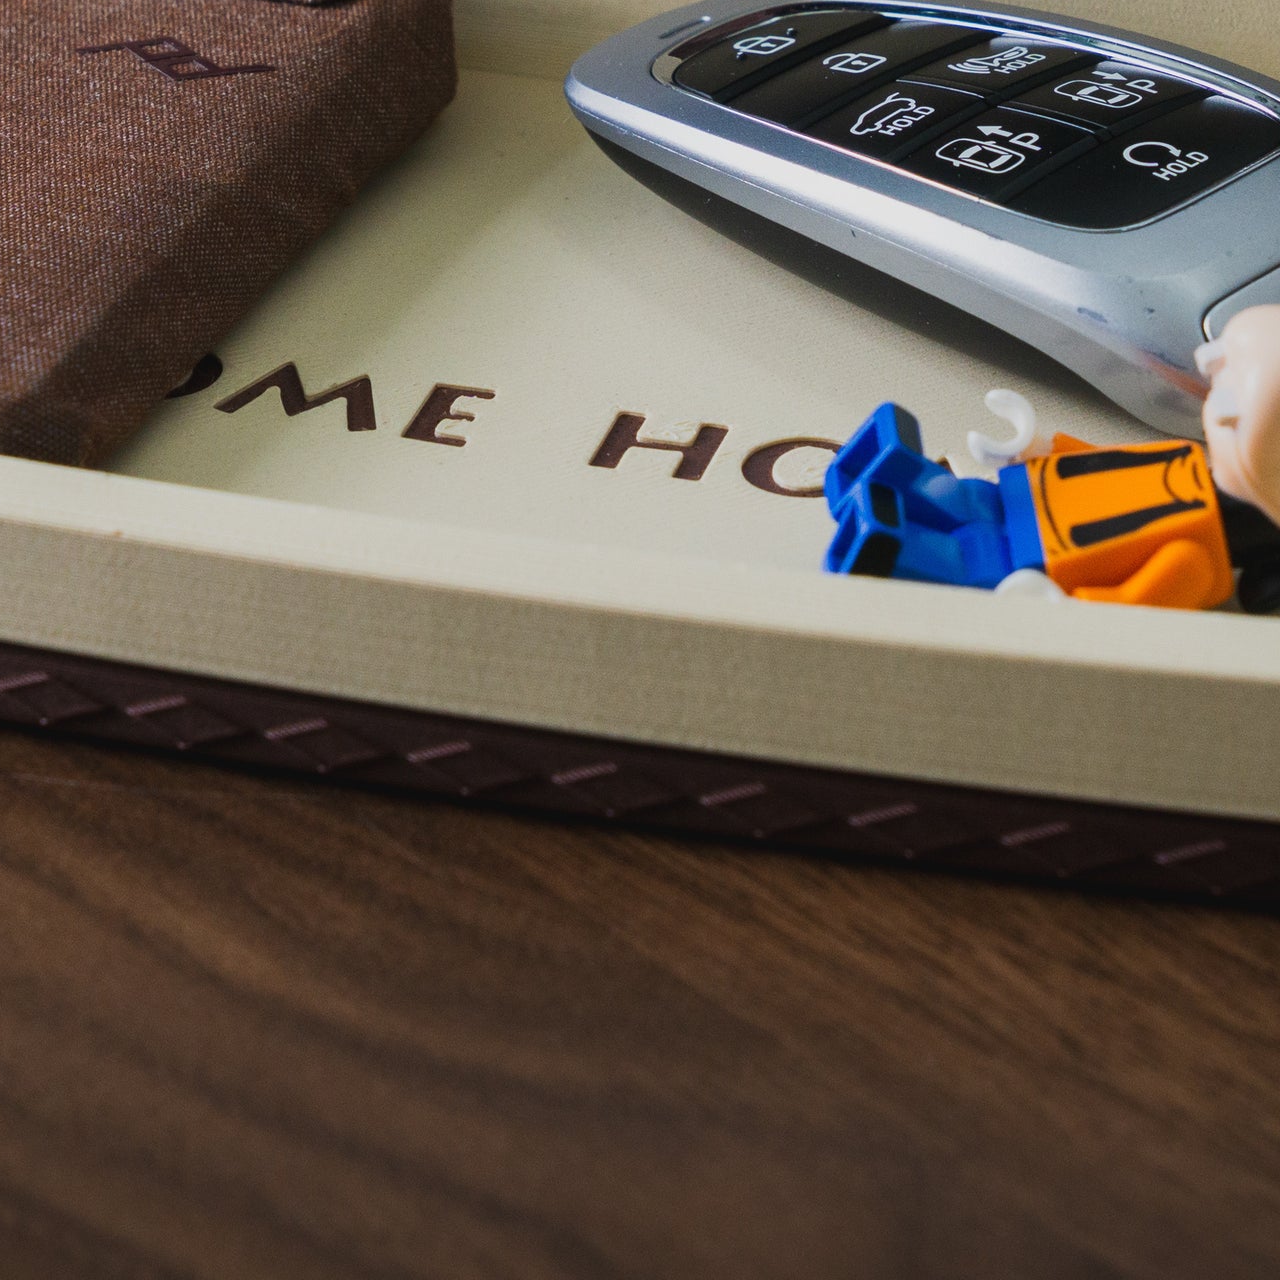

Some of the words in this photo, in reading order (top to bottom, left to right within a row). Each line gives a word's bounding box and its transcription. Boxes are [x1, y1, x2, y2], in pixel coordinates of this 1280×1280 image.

[993, 52, 1047, 75] HOLD
[1125, 78, 1159, 94] P
[878, 106, 936, 136] HOLD
[1008, 132, 1042, 151] P
[1152, 150, 1209, 181] HOLD
[164, 353, 496, 447] ME
[588, 411, 954, 499] HO
